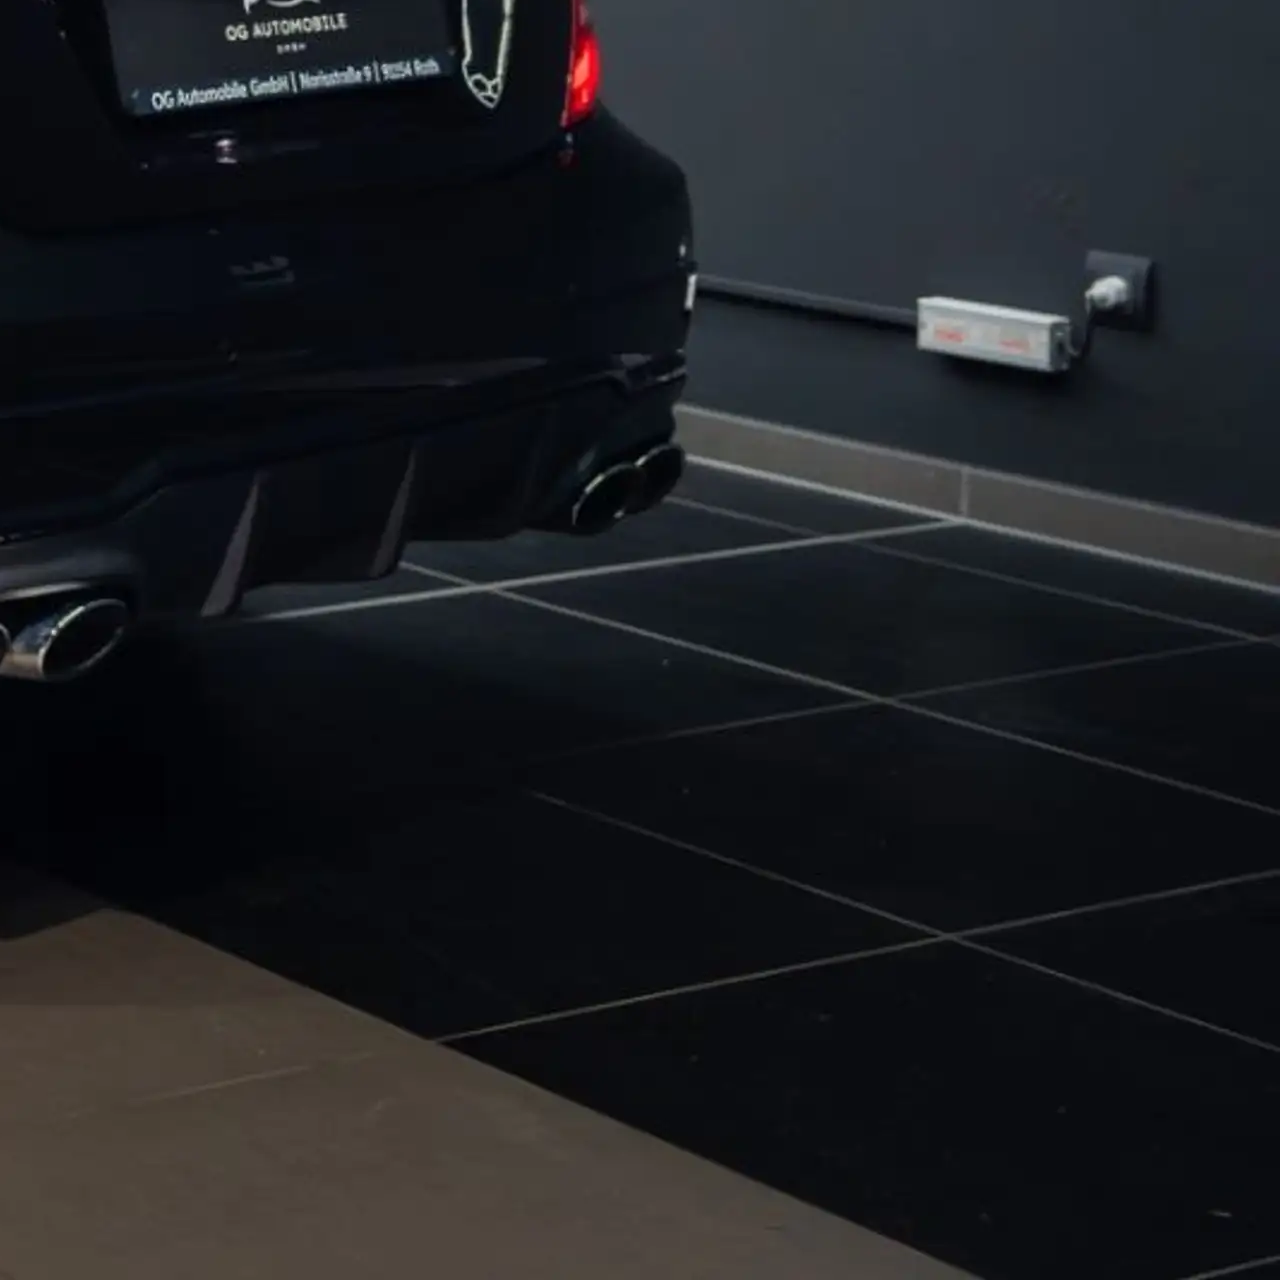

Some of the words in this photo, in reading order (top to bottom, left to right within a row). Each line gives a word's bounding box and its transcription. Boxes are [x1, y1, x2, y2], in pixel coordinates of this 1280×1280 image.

[225, 24, 249, 41] OG
[252, 12, 348, 38] AUTOMOBILE
[151, 90, 175, 111] OG
[177, 80, 248, 107] Automobile
[249, 75, 289, 96] GmbH
